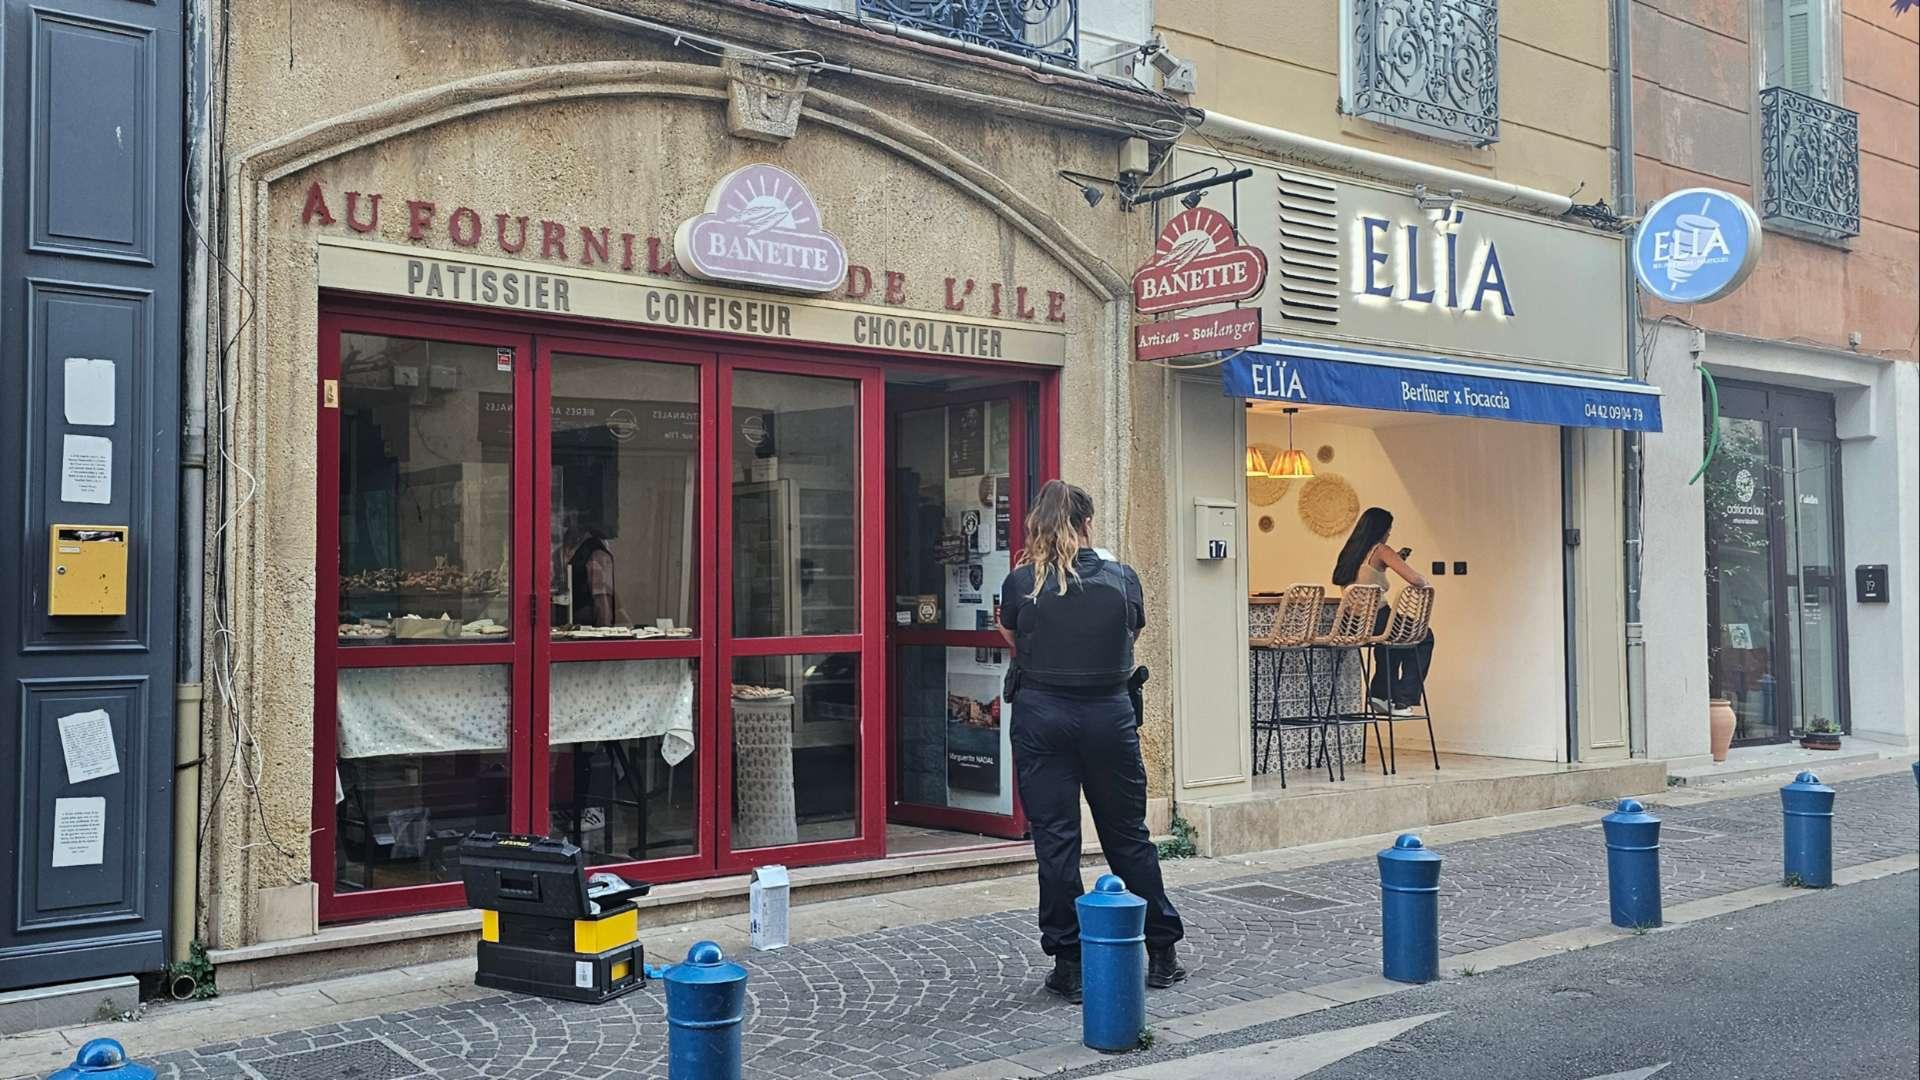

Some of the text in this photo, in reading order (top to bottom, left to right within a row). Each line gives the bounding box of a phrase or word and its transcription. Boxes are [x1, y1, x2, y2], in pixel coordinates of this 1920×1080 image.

[302, 180, 1067, 322] AU FOURNIL DE L'ILE
[708, 231, 830, 273] BANETTE
[1141, 261, 1248, 300] BANETTE
[407, 259, 1003, 358] PATISSIER CONFISEUR CHOCOLATIER
[1138, 331, 1180, 348] Artisan
[1192, 320, 1255, 341] Boulanger
[1252, 360, 1307, 399] ELÏA
[1401, 381, 1511, 409] Berliner x Focaccia
[1210, 541, 1226, 557] 17
